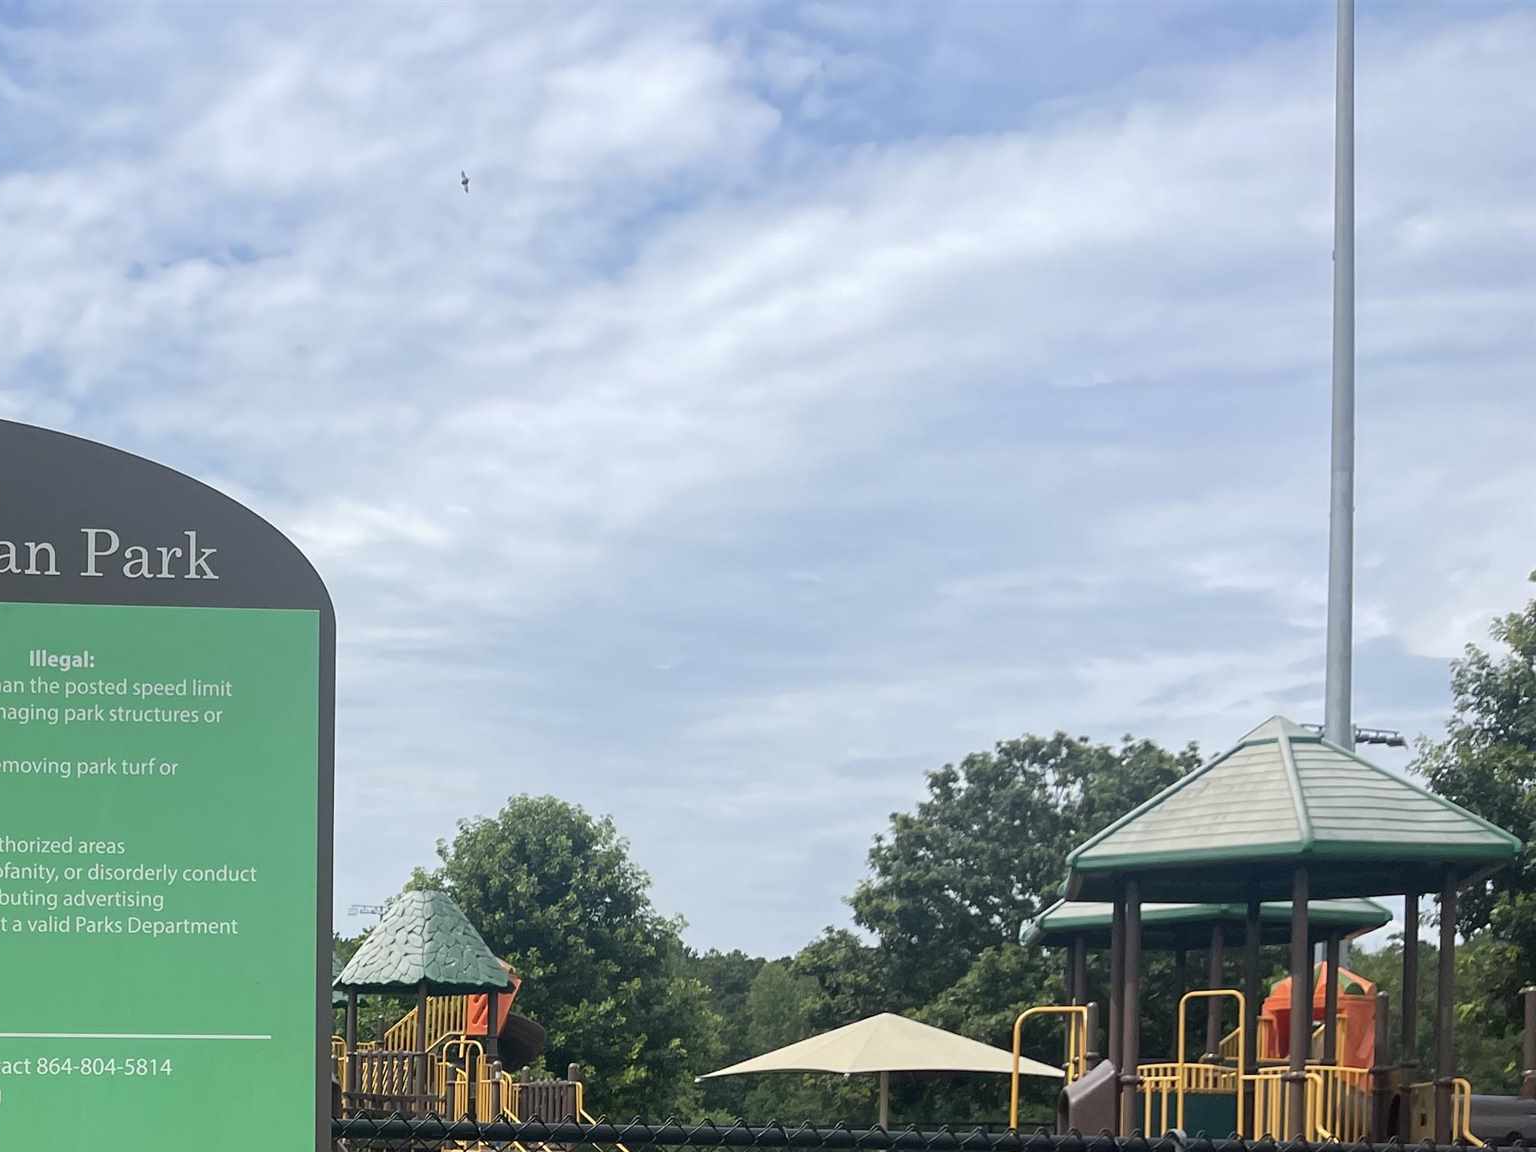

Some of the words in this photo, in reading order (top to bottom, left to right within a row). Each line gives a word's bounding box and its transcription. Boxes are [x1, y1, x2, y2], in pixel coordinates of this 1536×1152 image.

[79, 527, 220, 580] Park
[29, 649, 95, 673] Illegal:
[29, 675, 60, 695] the
[64, 677, 128, 699] posted
[132, 678, 187, 700] speed
[192, 678, 233, 697] limit
[64, 703, 105, 725] park
[108, 706, 200, 723] structures
[203, 710, 224, 724] or
[76, 757, 118, 779] park
[121, 757, 157, 776] turf
[159, 762, 179, 776] or
[77, 840, 126, 855] areas
[63, 867, 83, 881] or
[87, 862, 178, 886] disorderly
[182, 863, 257, 883] conduct
[11, 919, 23, 933] a
[26, 914, 71, 933] valid
[75, 915, 123, 934] Parks
[127, 916, 239, 938] Department
[36, 1056, 173, 1076] 864-804-5814
